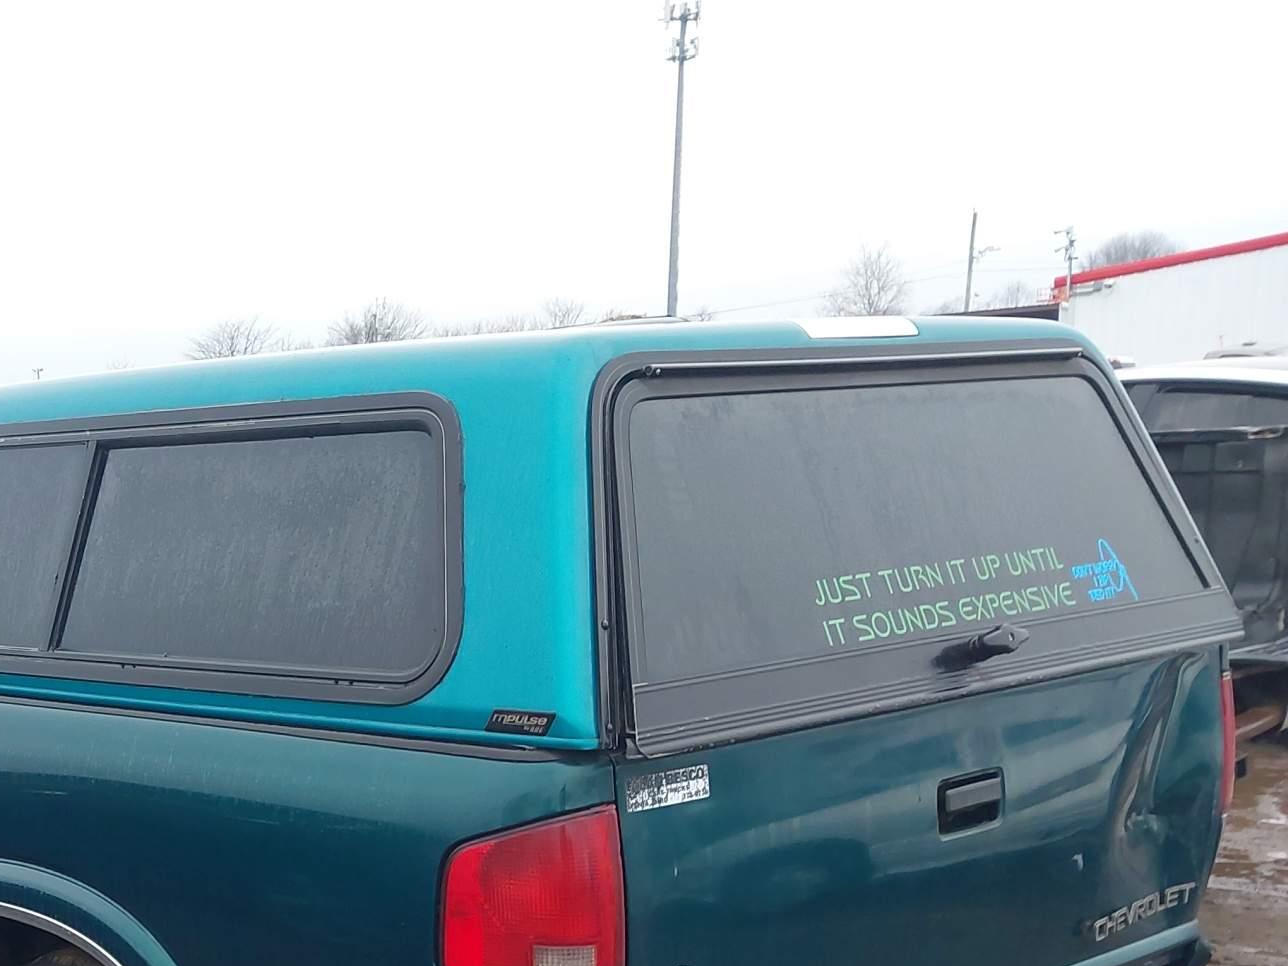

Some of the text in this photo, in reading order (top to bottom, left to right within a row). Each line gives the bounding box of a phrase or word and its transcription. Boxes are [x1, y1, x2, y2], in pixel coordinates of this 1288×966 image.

[815, 573, 871, 606] JUST
[877, 562, 945, 594] TURN
[945, 558, 966, 584] IT
[971, 554, 1001, 580] UP
[1004, 547, 1065, 576] UNTIL
[822, 581, 1077, 646] IT SOUNDS EXPENSIVE
[1094, 881, 1196, 942] CHEVROLET
